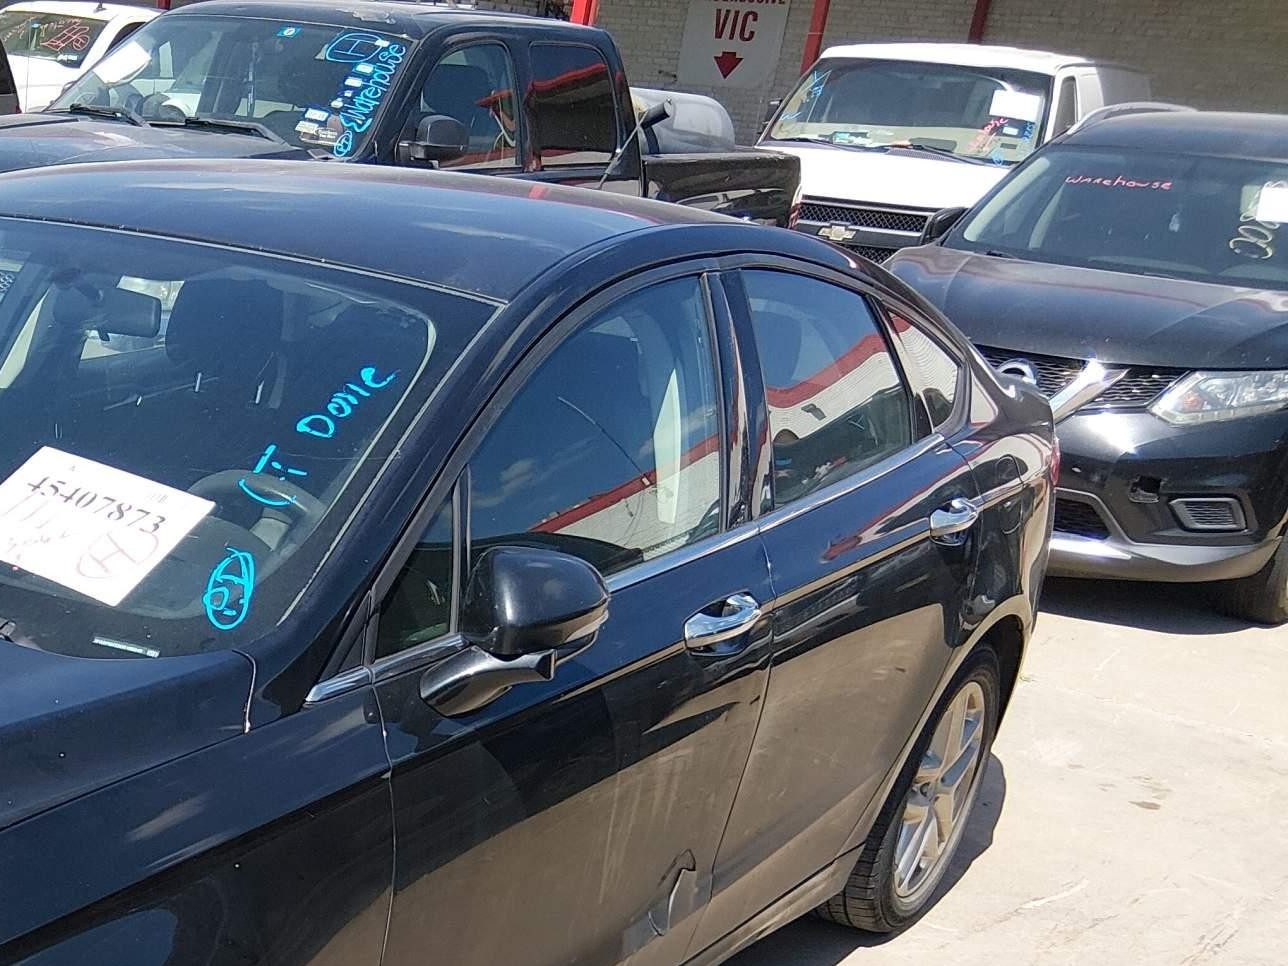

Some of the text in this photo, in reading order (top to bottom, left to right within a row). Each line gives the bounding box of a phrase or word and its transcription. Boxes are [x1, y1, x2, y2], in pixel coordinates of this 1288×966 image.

[715, 8, 758, 41] VIC
[296, 366, 401, 438] Done
[27, 476, 167, 534] 45407873
